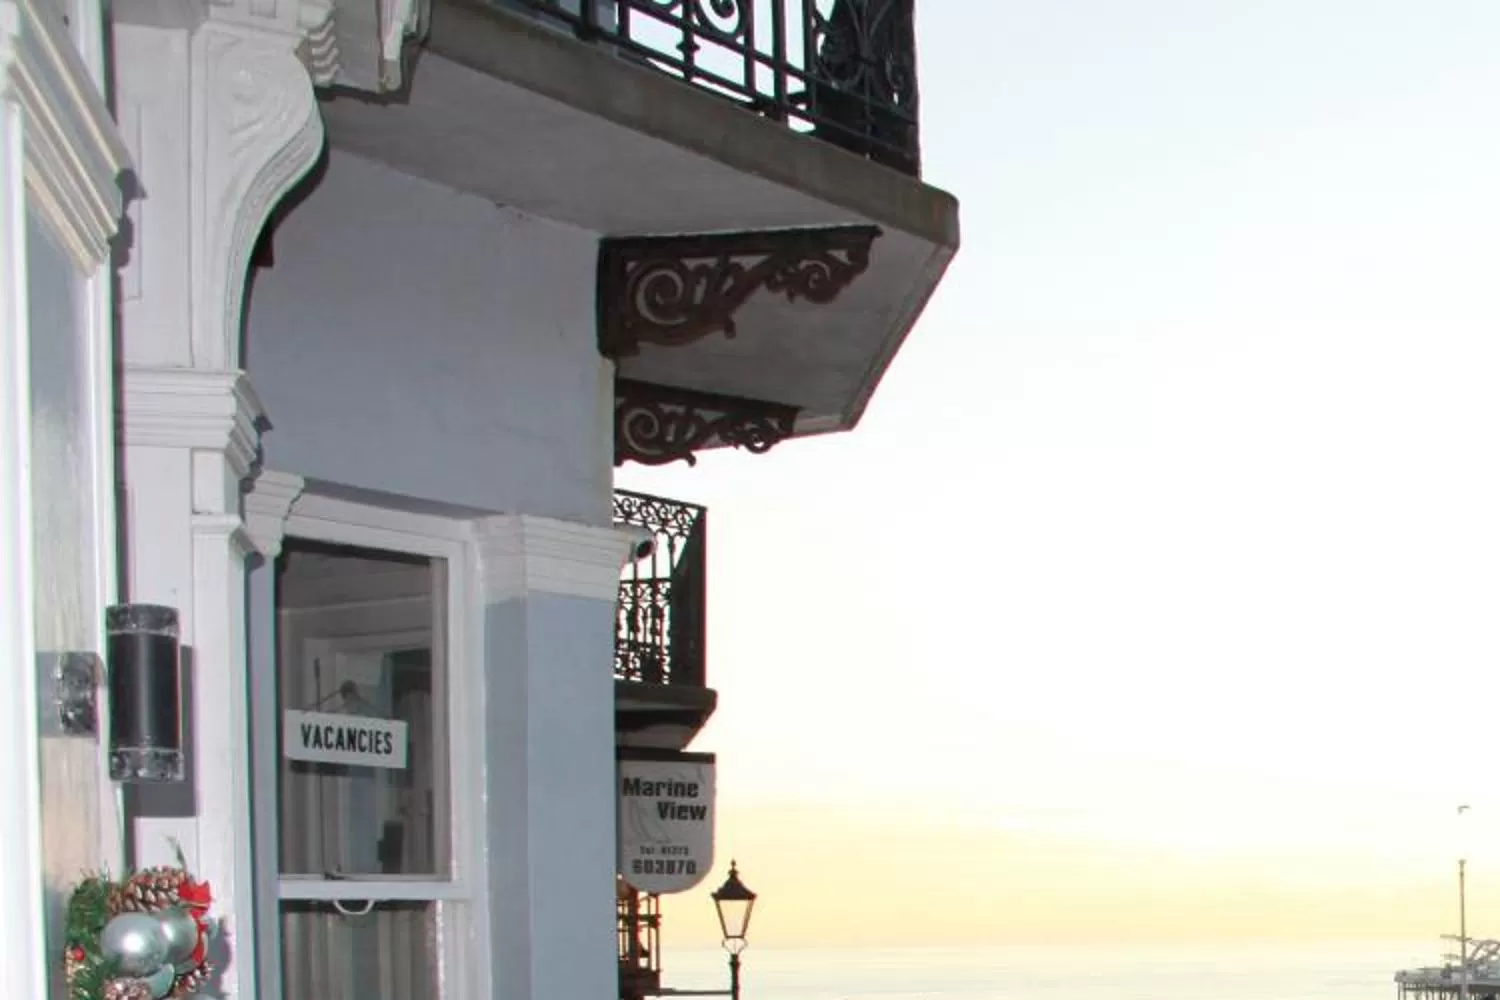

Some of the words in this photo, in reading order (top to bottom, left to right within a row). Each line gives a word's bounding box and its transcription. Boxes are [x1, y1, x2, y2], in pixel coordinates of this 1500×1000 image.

[301, 723, 393, 755] VACANCIES
[622, 777, 699, 798] Marine
[657, 801, 707, 821] View
